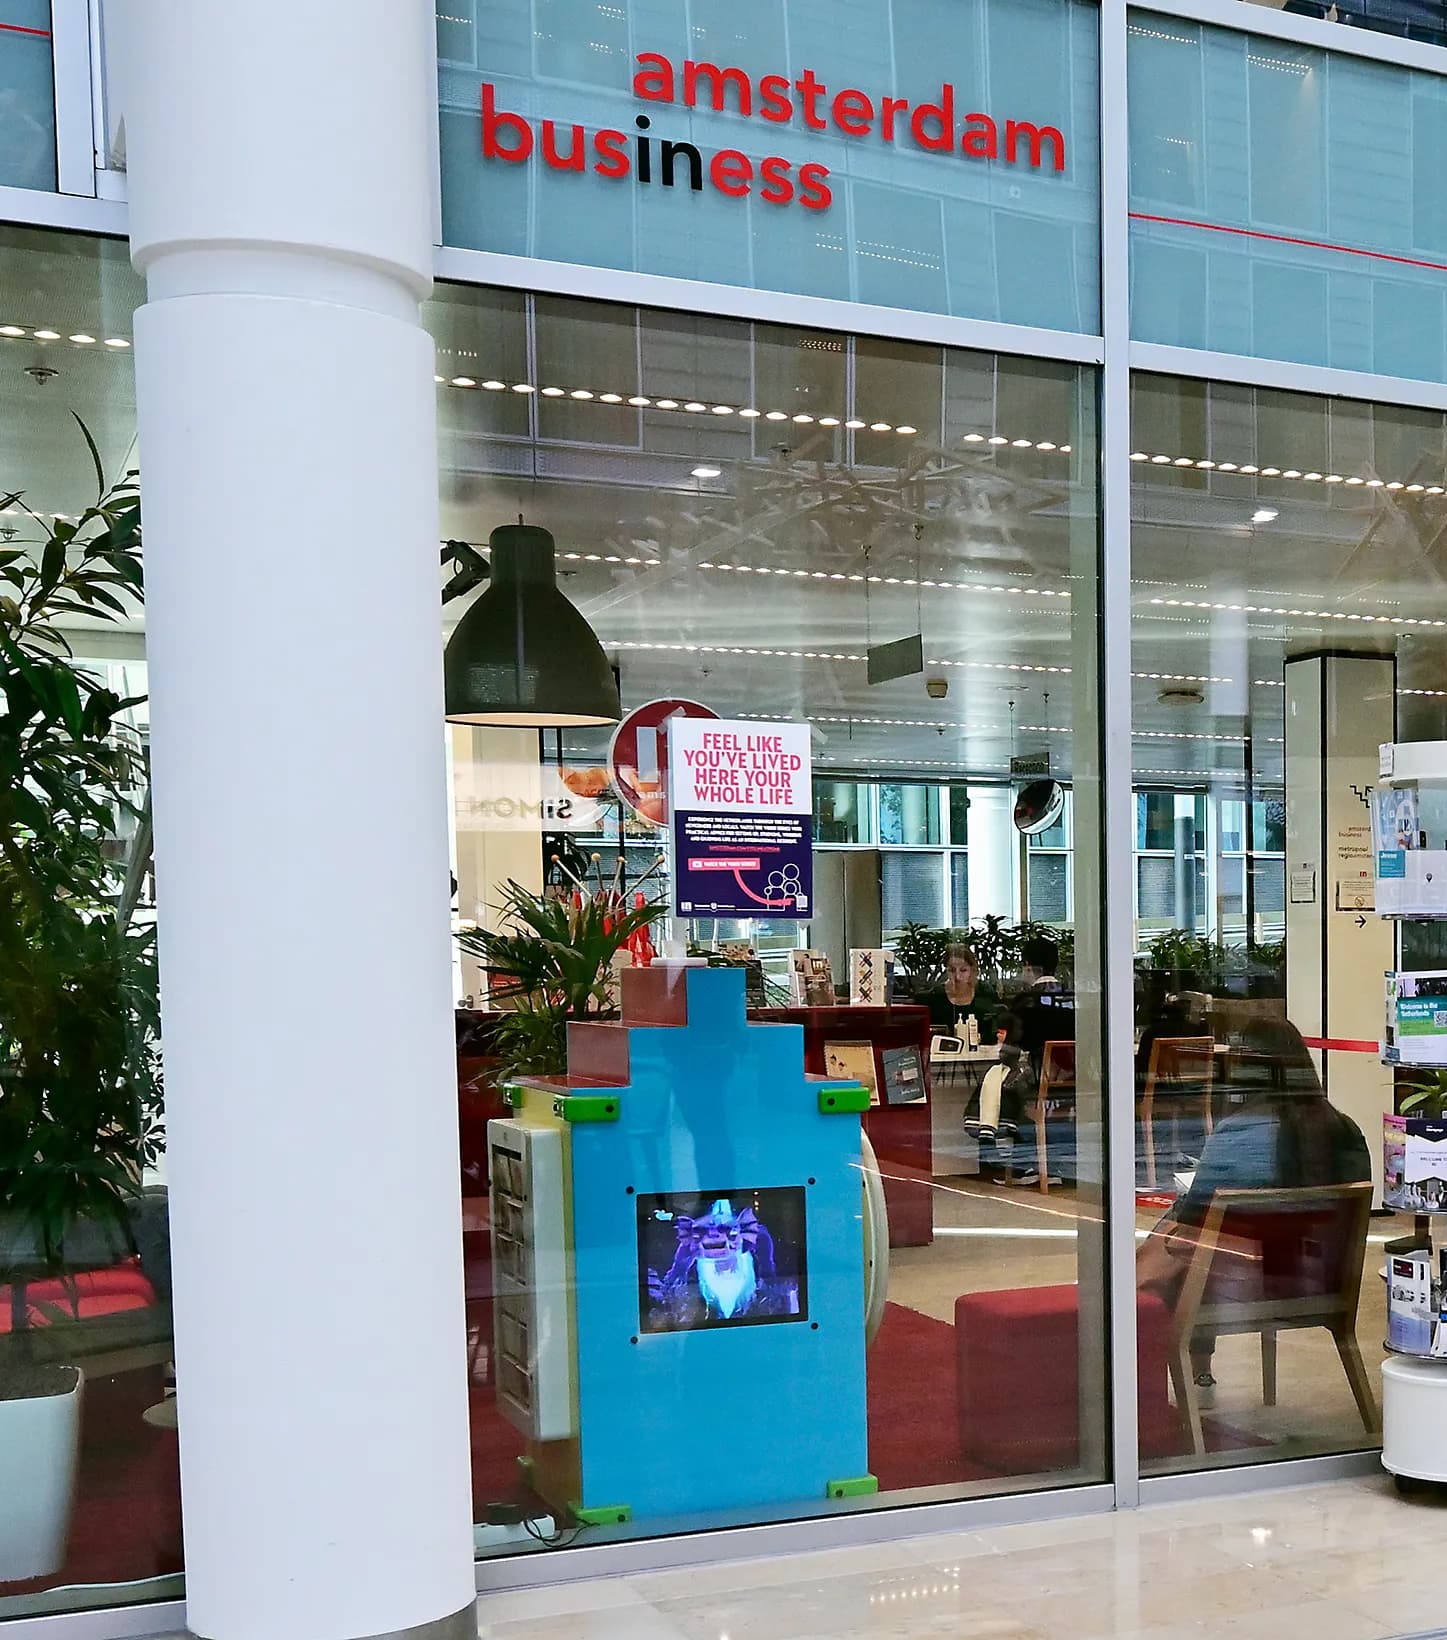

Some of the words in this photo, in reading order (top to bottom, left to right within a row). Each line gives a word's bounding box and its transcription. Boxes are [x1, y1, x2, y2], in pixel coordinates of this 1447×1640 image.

[633, 52, 1065, 171] amsterdam
[481, 83, 832, 210] business
[703, 733, 741, 751] FEEL
[747, 735, 782, 753] LIKE
[684, 750, 747, 769] YOU'VE
[752, 753, 801, 771] LIVED
[695, 768, 739, 786] HERE
[745, 770, 791, 788] YOUR
[694, 785, 754, 804] WHOLE
[759, 788, 793, 805] LIFE
